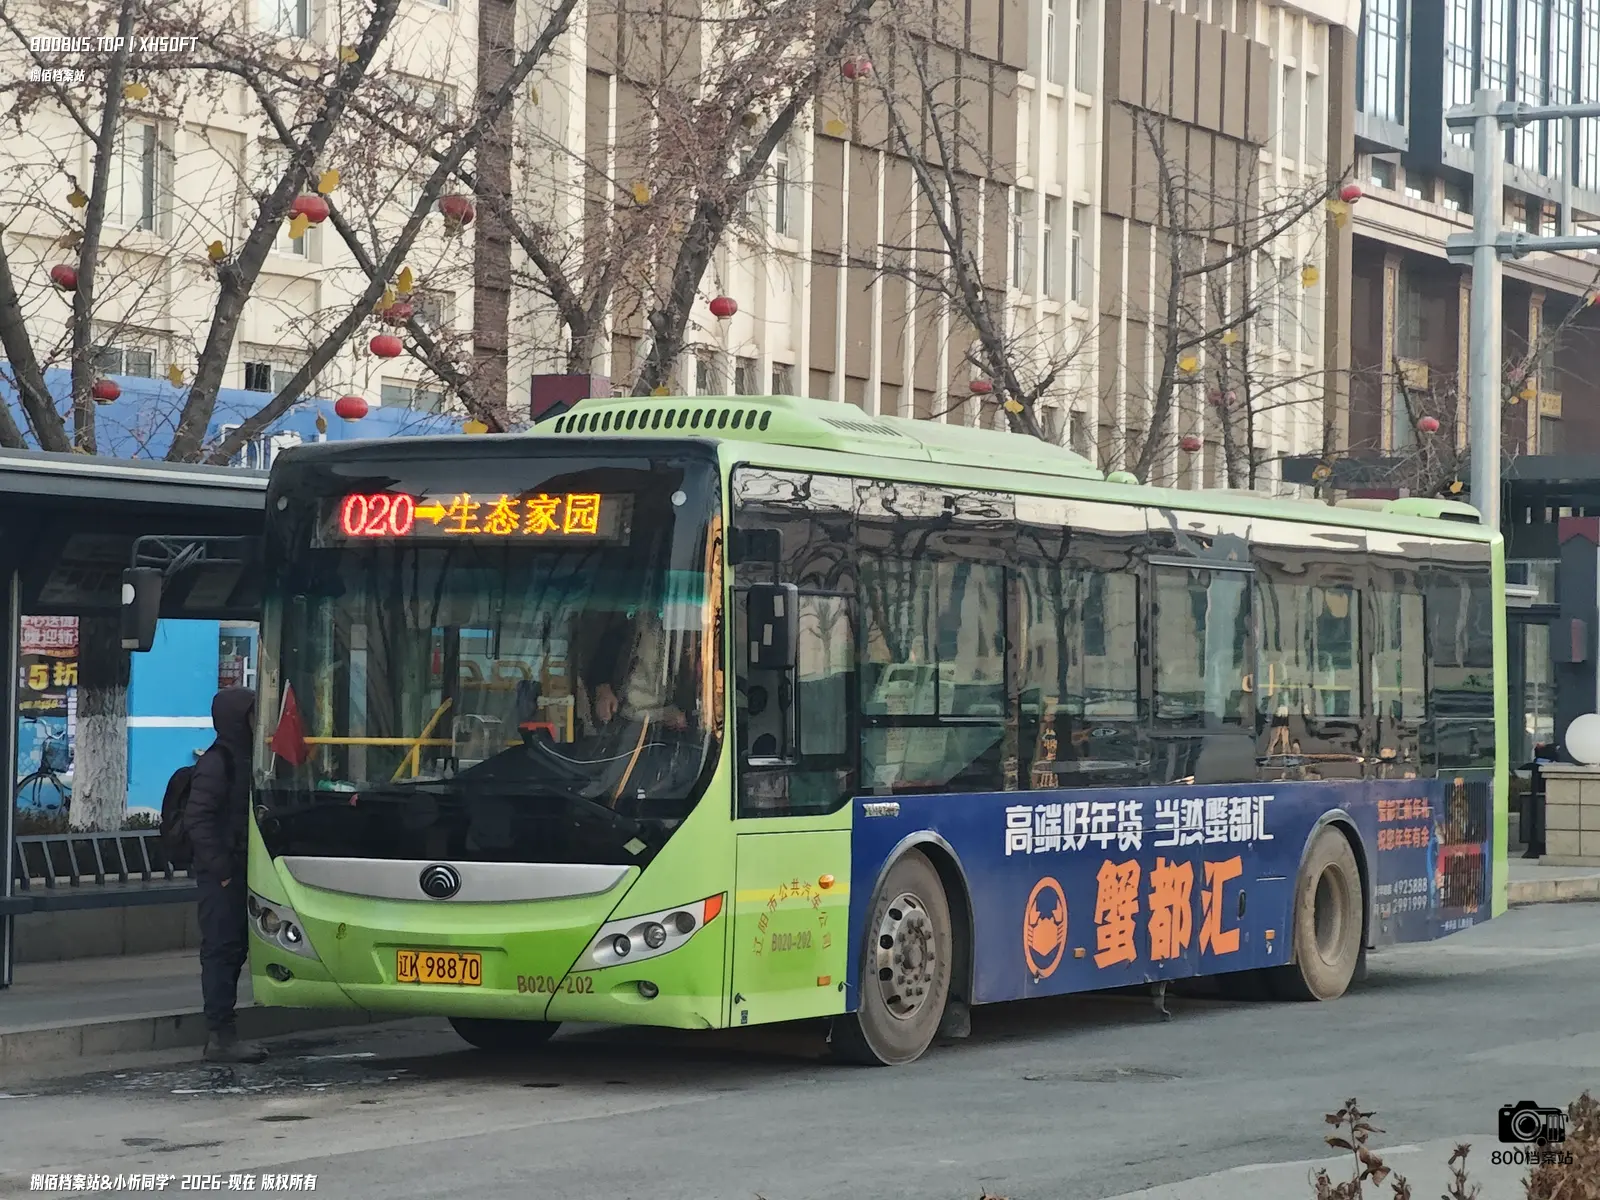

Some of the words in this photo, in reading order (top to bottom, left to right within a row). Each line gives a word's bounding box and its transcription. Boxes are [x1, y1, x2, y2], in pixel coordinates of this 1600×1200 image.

[341, 493, 415, 536] 020
[444, 492, 602, 535] 生态家园
[1004, 800, 1144, 856] 高端好年货
[1154, 795, 1276, 848] 当然蟹都汇
[1093, 855, 1243, 969] 蟹都汇
[517, 975, 595, 994] B020-202
